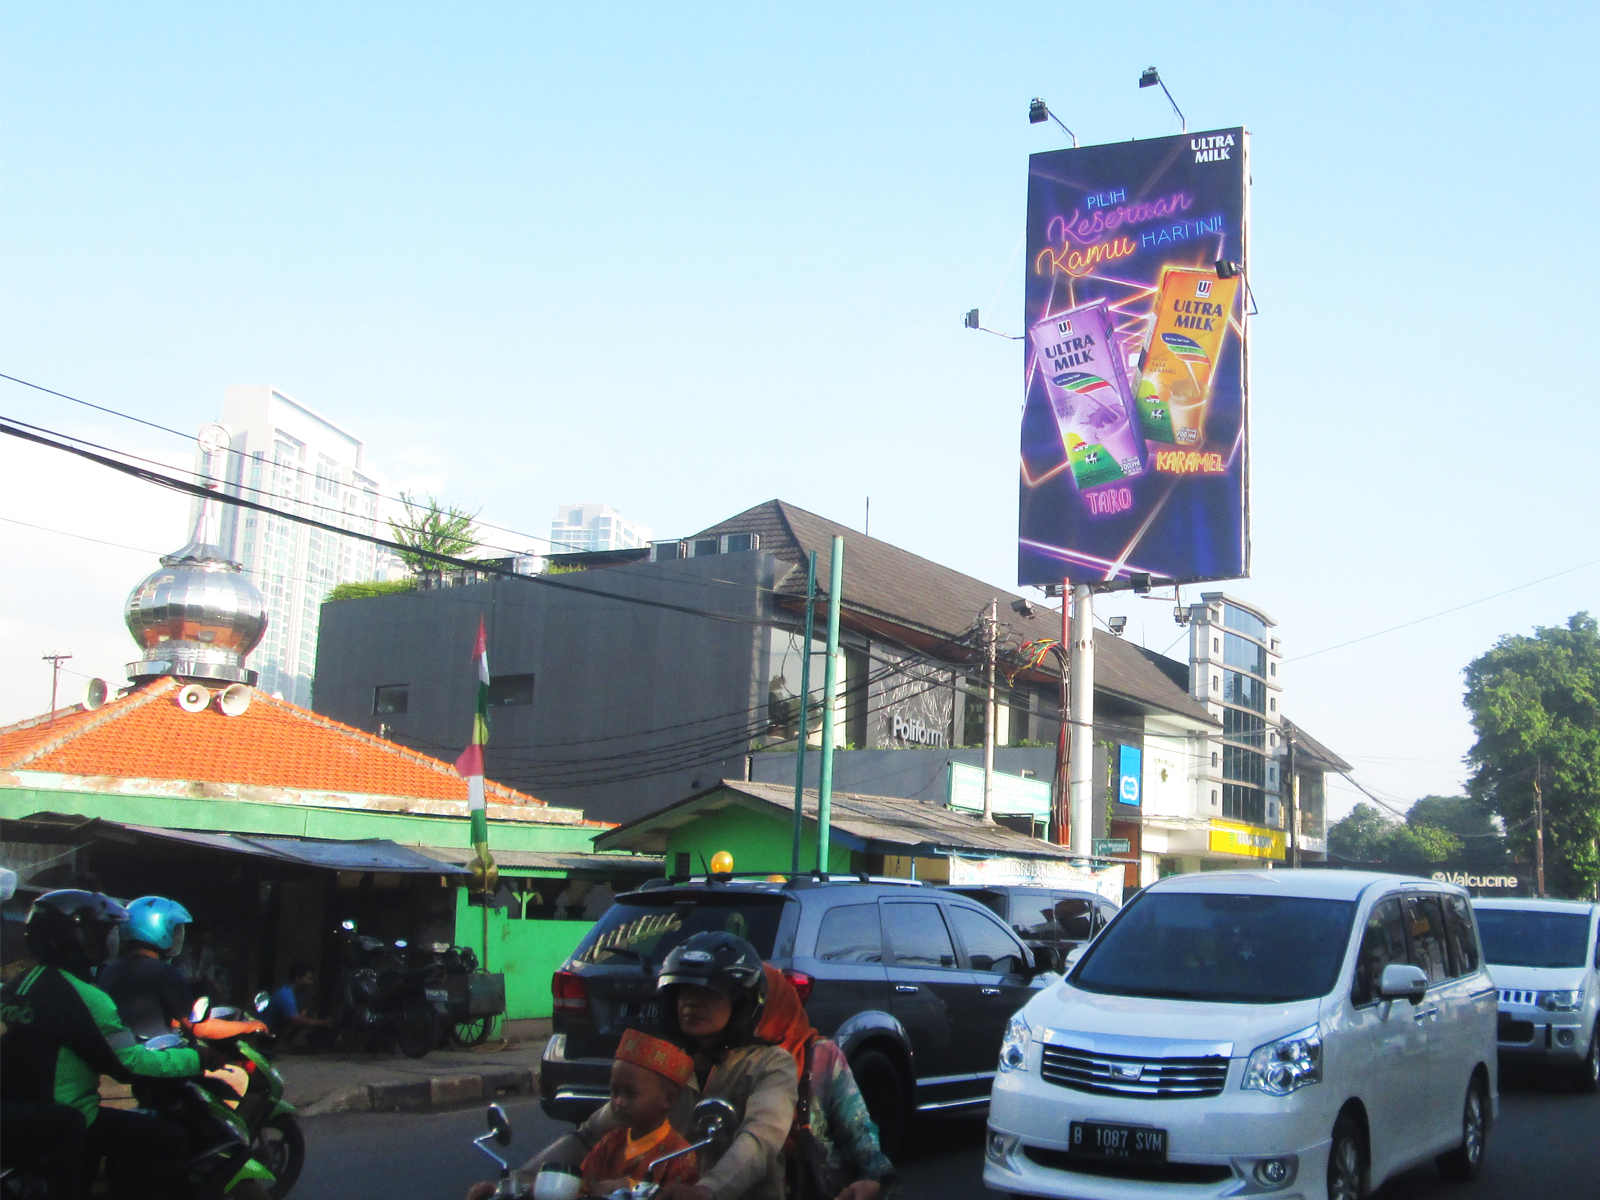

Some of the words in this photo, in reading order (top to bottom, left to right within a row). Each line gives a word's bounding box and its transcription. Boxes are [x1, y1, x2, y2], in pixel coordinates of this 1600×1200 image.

[1191, 134, 1234, 151] ULTRA
[1195, 148, 1230, 163] MILK
[1087, 189, 1126, 209] PILIH
[1047, 192, 1192, 244] Keseruan
[1036, 237, 1136, 278] Kamu
[1141, 226, 1189, 248] HARI
[1195, 216, 1223, 236] INI!
[1173, 299, 1224, 318] ULTRA
[1174, 314, 1216, 332] MILK
[1044, 333, 1096, 359] ULTRA
[1053, 349, 1095, 373] MILK
[1157, 451, 1226, 474] KARAMEL
[1086, 488, 1132, 515] TARO
[893, 715, 943, 748] Poliform
[1446, 871, 1518, 888] Valcucine
[1074, 1126, 1082, 1144] B
[1096, 1128, 1128, 1148] 1087
[1135, 1132, 1162, 1151] SVM
